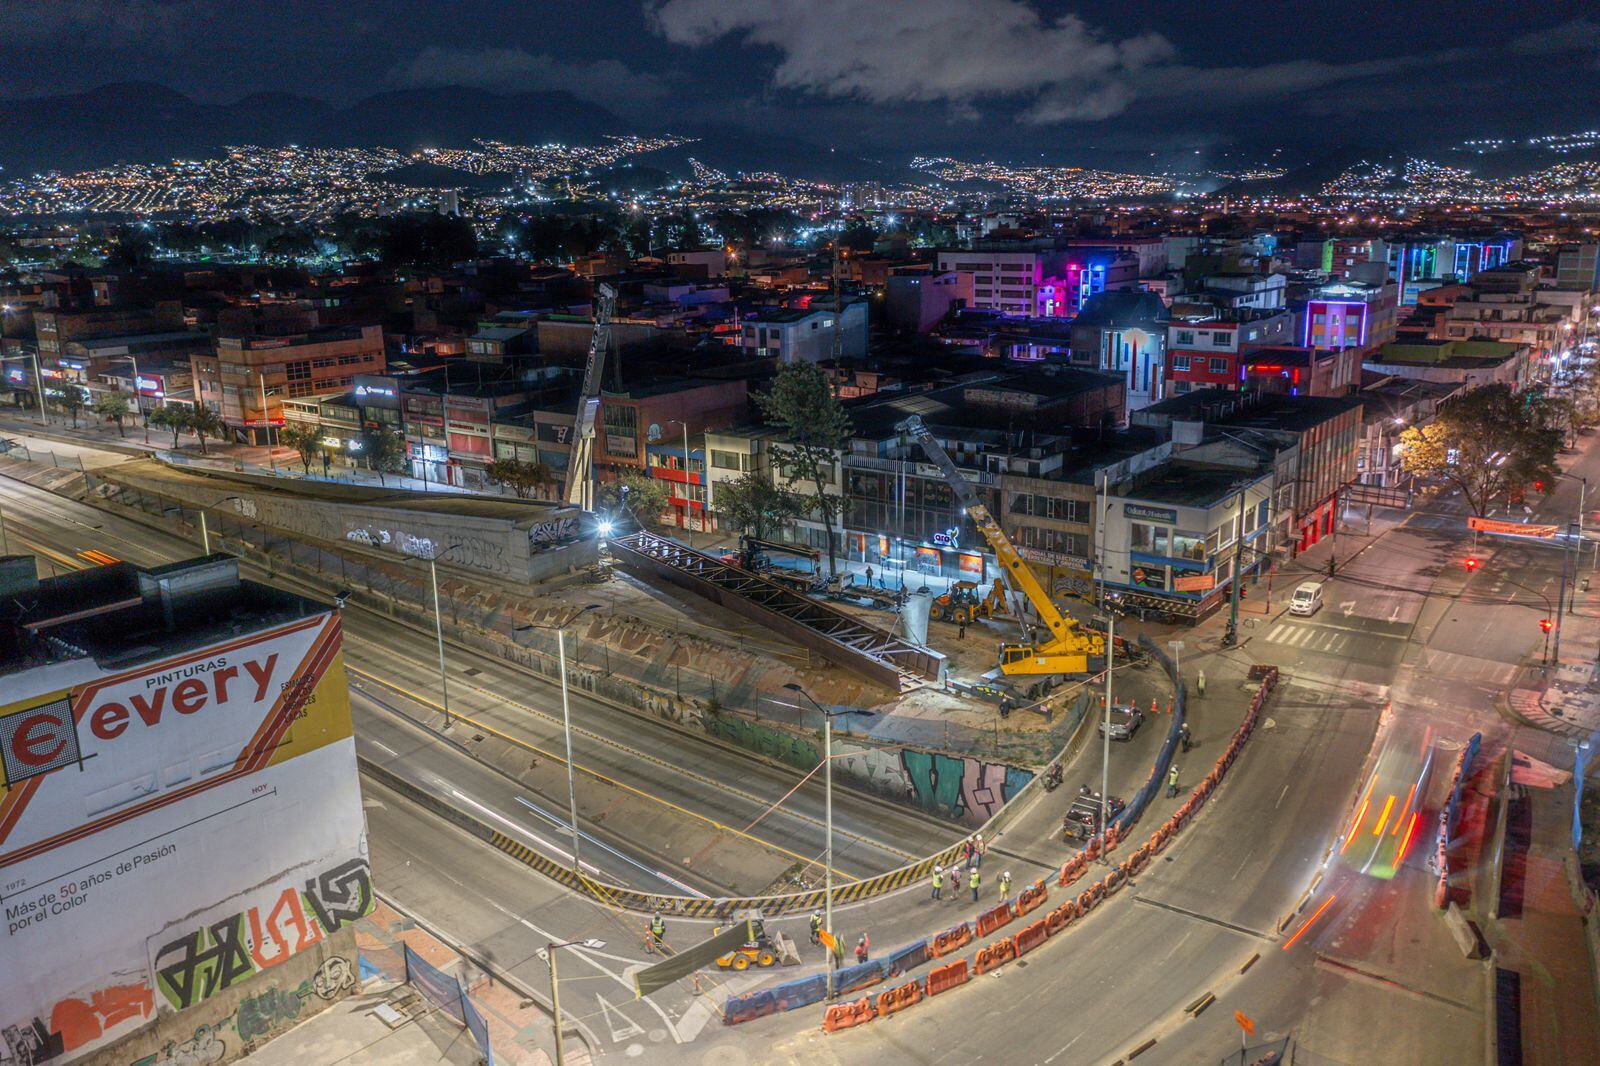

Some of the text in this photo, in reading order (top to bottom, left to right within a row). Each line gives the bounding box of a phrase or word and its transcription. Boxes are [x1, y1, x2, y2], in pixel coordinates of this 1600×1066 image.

[934, 533, 951, 544] ara
[146, 657, 227, 688] PINTURAS
[90, 653, 279, 740] every
[252, 784, 268, 795] HOY
[5, 878, 26, 892] 1972
[6, 843, 177, 920] Más de 50 años de Pasión
[9, 892, 88, 935] por el Color
